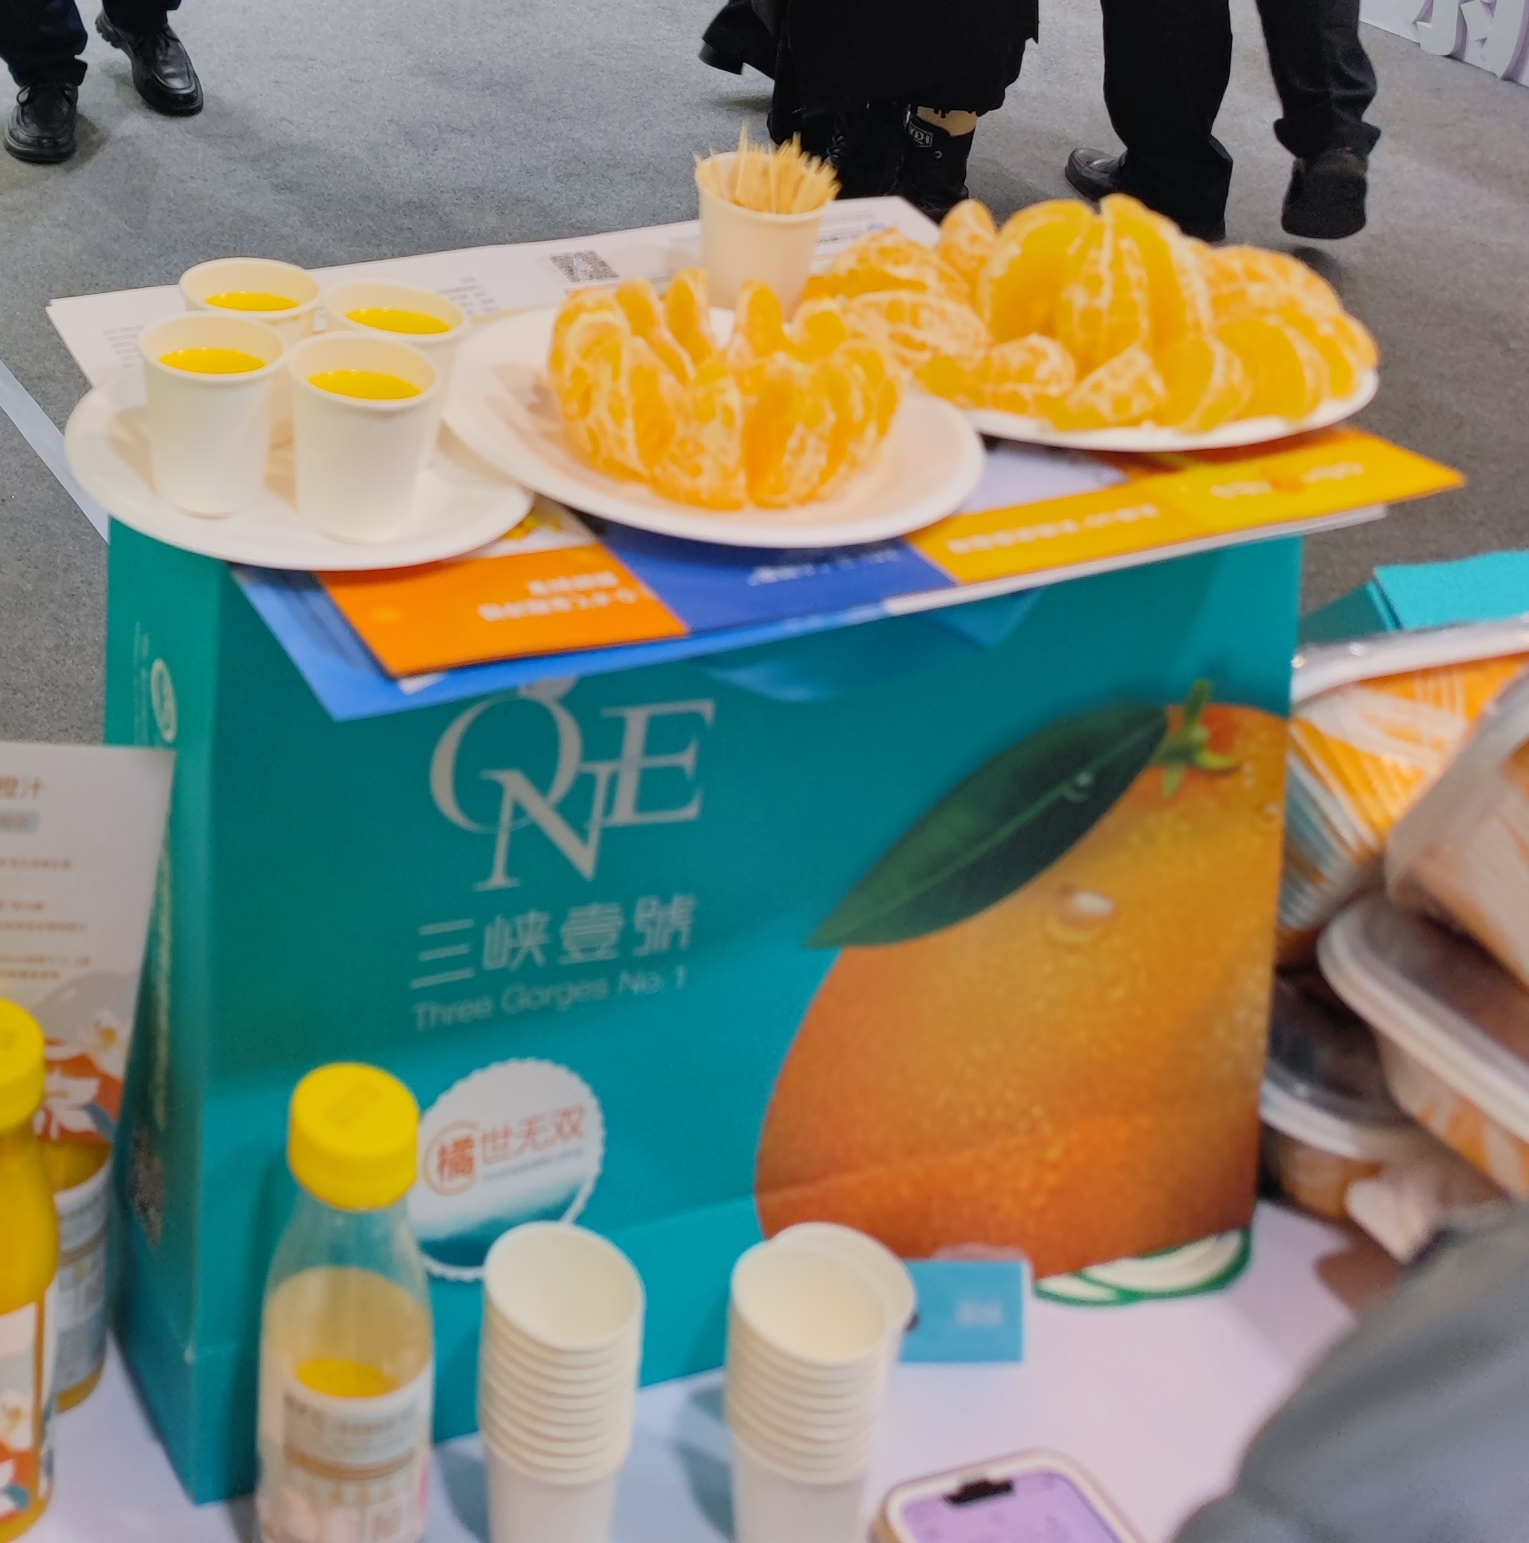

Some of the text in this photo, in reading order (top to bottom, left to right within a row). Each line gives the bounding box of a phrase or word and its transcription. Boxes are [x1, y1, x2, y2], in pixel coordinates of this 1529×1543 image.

[409, 894, 698, 990] 三峡壹號
[415, 995, 495, 1032] Three
[500, 978, 611, 1016] Gorges
